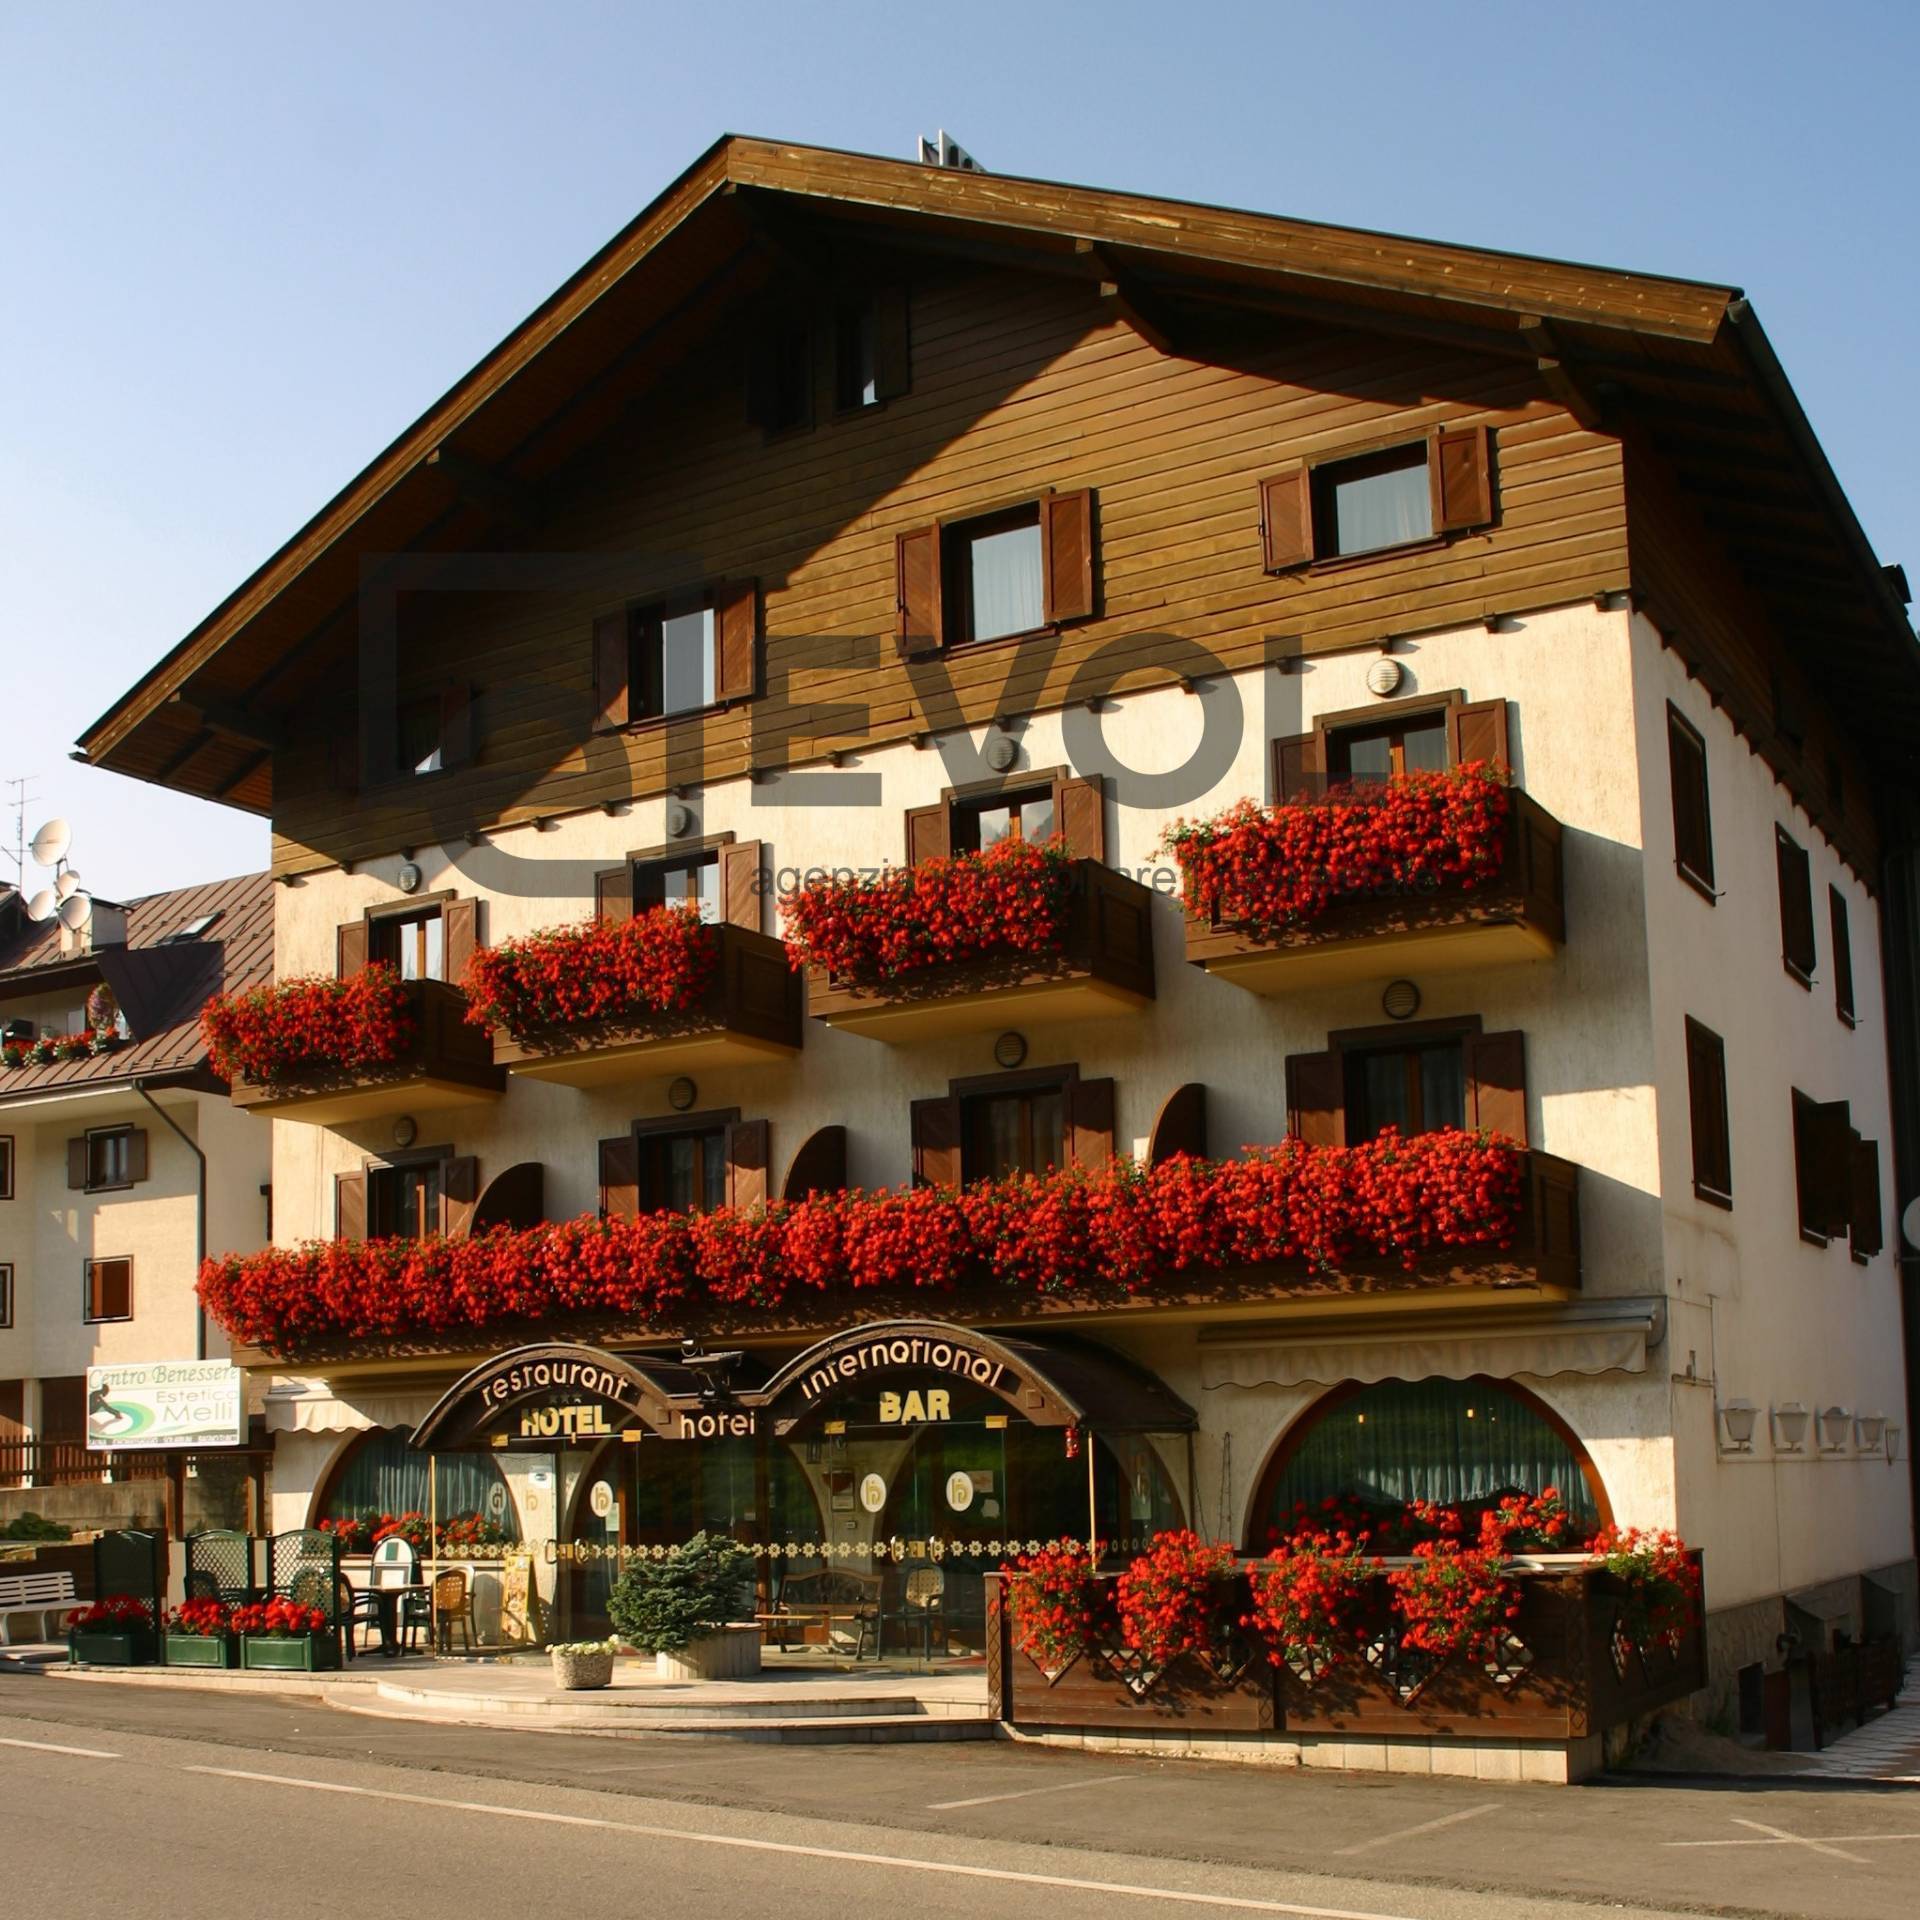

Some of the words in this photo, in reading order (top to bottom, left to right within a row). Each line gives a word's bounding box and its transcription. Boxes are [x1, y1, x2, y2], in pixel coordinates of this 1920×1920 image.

[89, 1368, 146, 1389] Centro
[152, 1364, 238, 1384] Benessere
[482, 1363, 629, 1406] restaurant
[802, 1340, 1004, 1400] international
[163, 1401, 232, 1423] Melli
[520, 1405, 611, 1436] HOTEL
[879, 1389, 951, 1423] BAR
